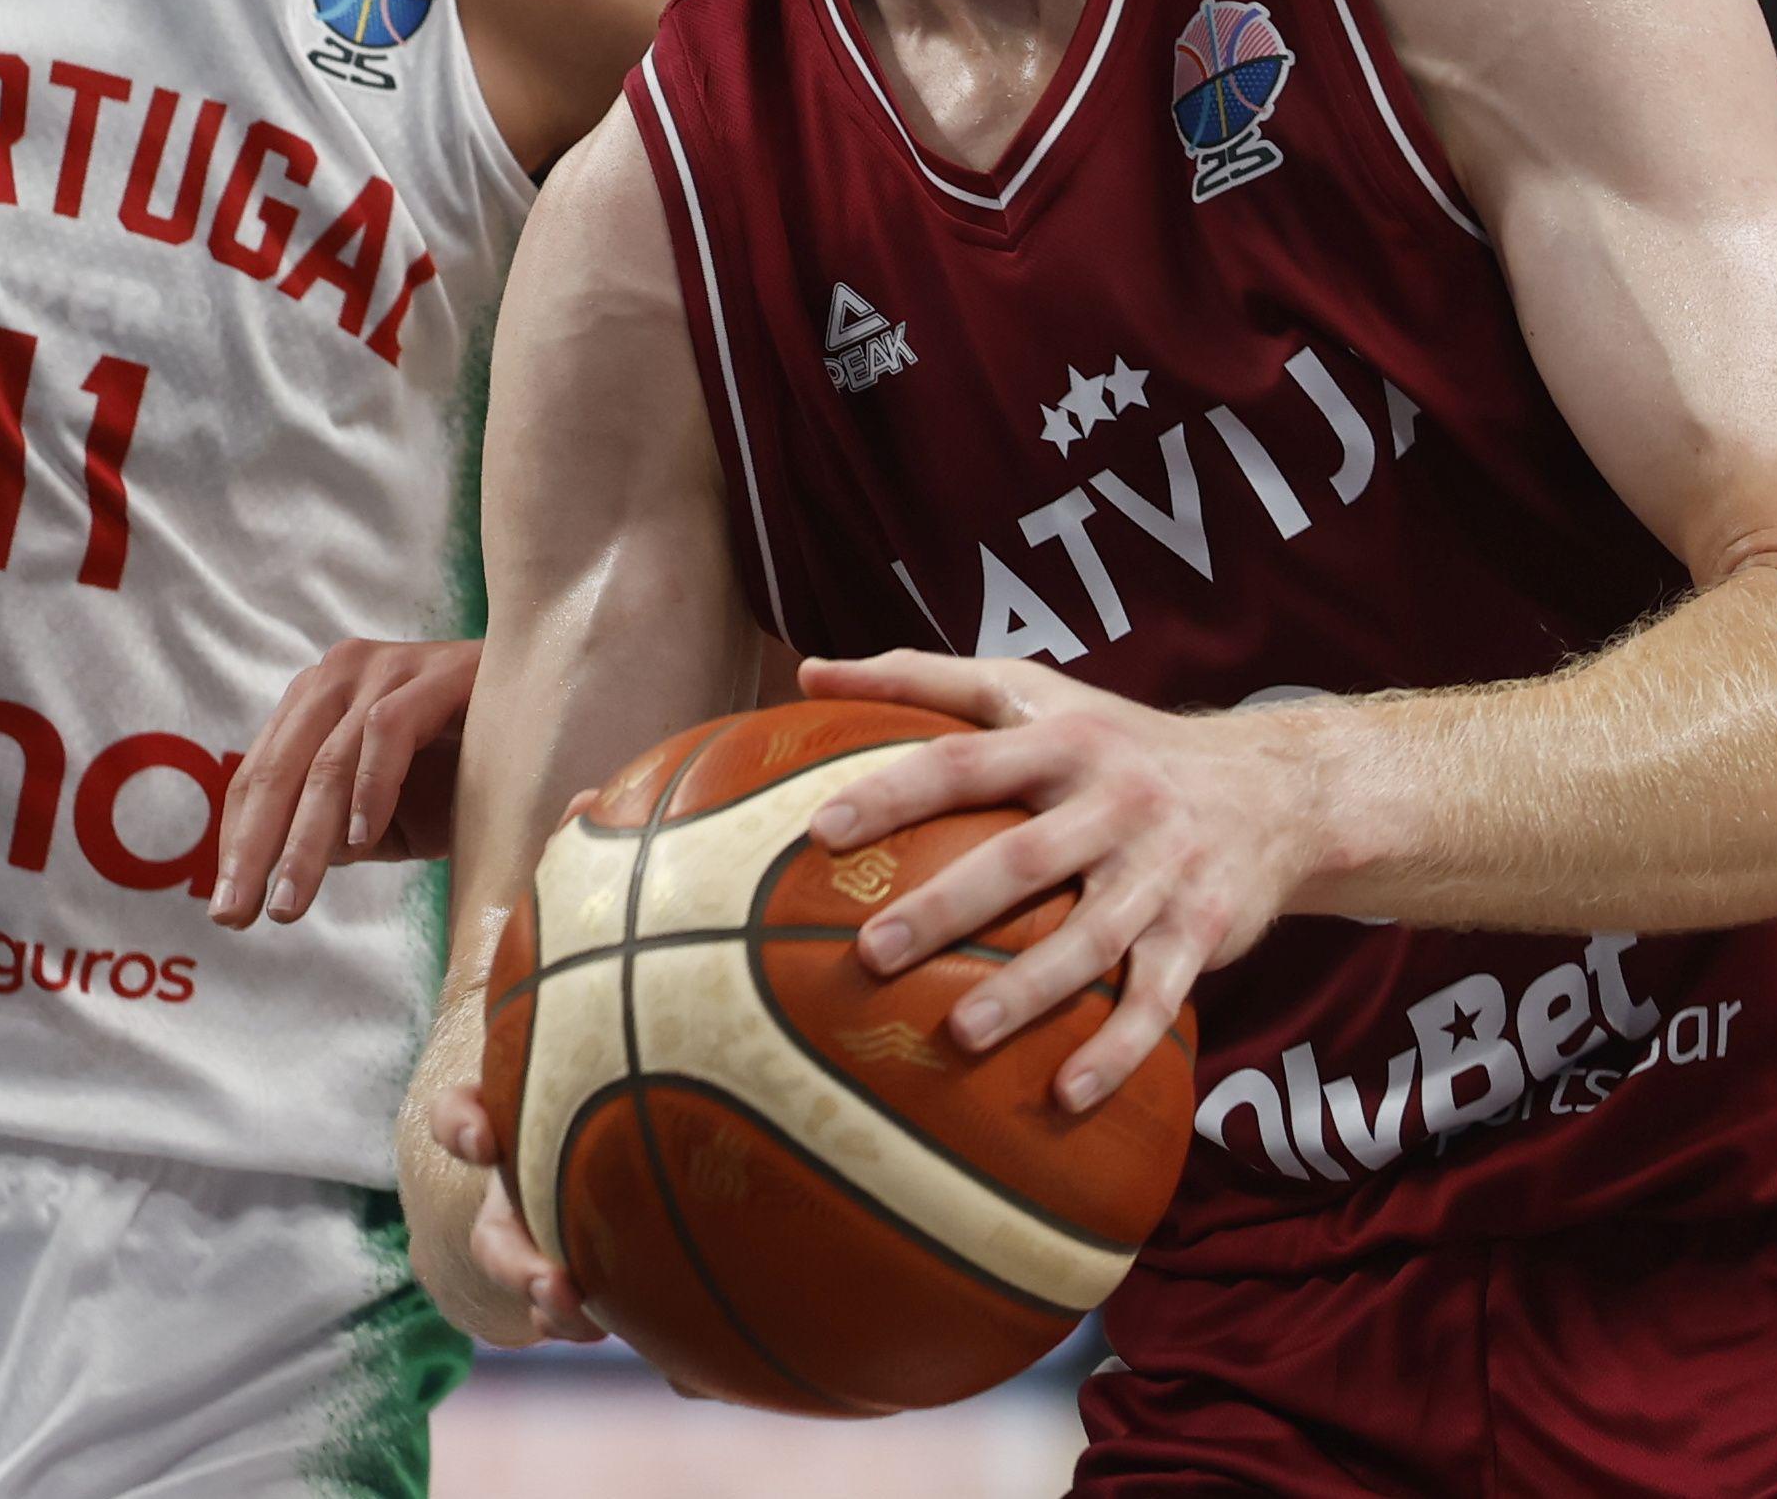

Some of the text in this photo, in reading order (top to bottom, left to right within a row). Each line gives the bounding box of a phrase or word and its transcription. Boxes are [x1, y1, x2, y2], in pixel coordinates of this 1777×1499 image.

[308, 37, 397, 90] 25
[1195, 130, 1277, 197] 25
[823, 320, 920, 394] PEAK
[890, 345, 1421, 666] ATVIJ
